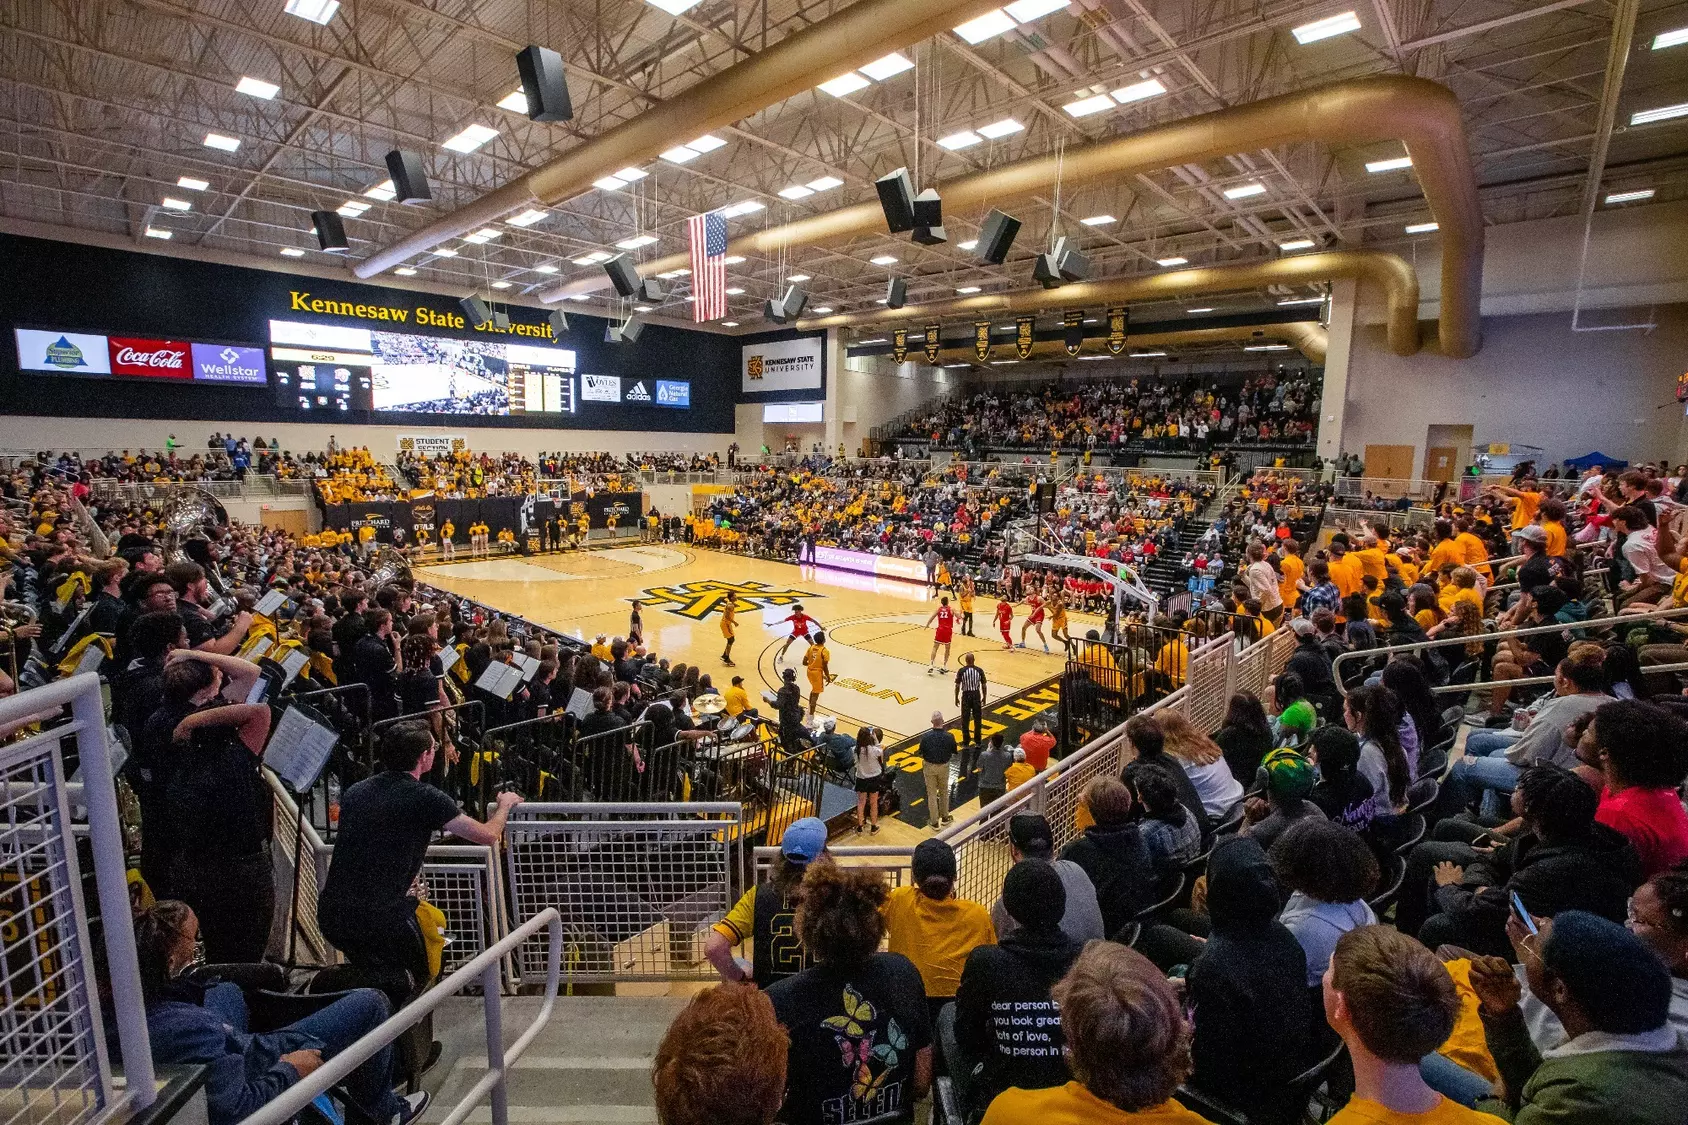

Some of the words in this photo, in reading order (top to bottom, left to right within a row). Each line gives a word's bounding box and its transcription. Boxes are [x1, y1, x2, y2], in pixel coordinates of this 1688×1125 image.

[289, 291, 409, 322] Kennesaw
[415, 307, 465, 329] State
[473, 319, 559, 344] versit
[116, 347, 186, 369] Coca-Cola
[765, 357, 797, 366] KENNESAW
[797, 355, 815, 363] STATE
[200, 363, 259, 377] Wellstar
[764, 363, 815, 374] UNIVERSITY
[668, 384, 688, 392] Georgia
[626, 393, 651, 401] adidas
[351, 518, 390, 527] PRIHARD
[940, 611, 949, 619] 22
[991, 683, 1060, 721] ATE
[991, 1001, 1012, 1011] dear
[1014, 1002, 1051, 1012] person
[994, 1017, 1010, 1026] you
[1011, 1015, 1033, 1026] look
[996, 1029, 1010, 1041] lots
[1012, 1030, 1025, 1041] of
[1026, 1030, 1052, 1042] love,
[1013, 1046, 1048, 1057] person
[1050, 1045, 1059, 1056] in
